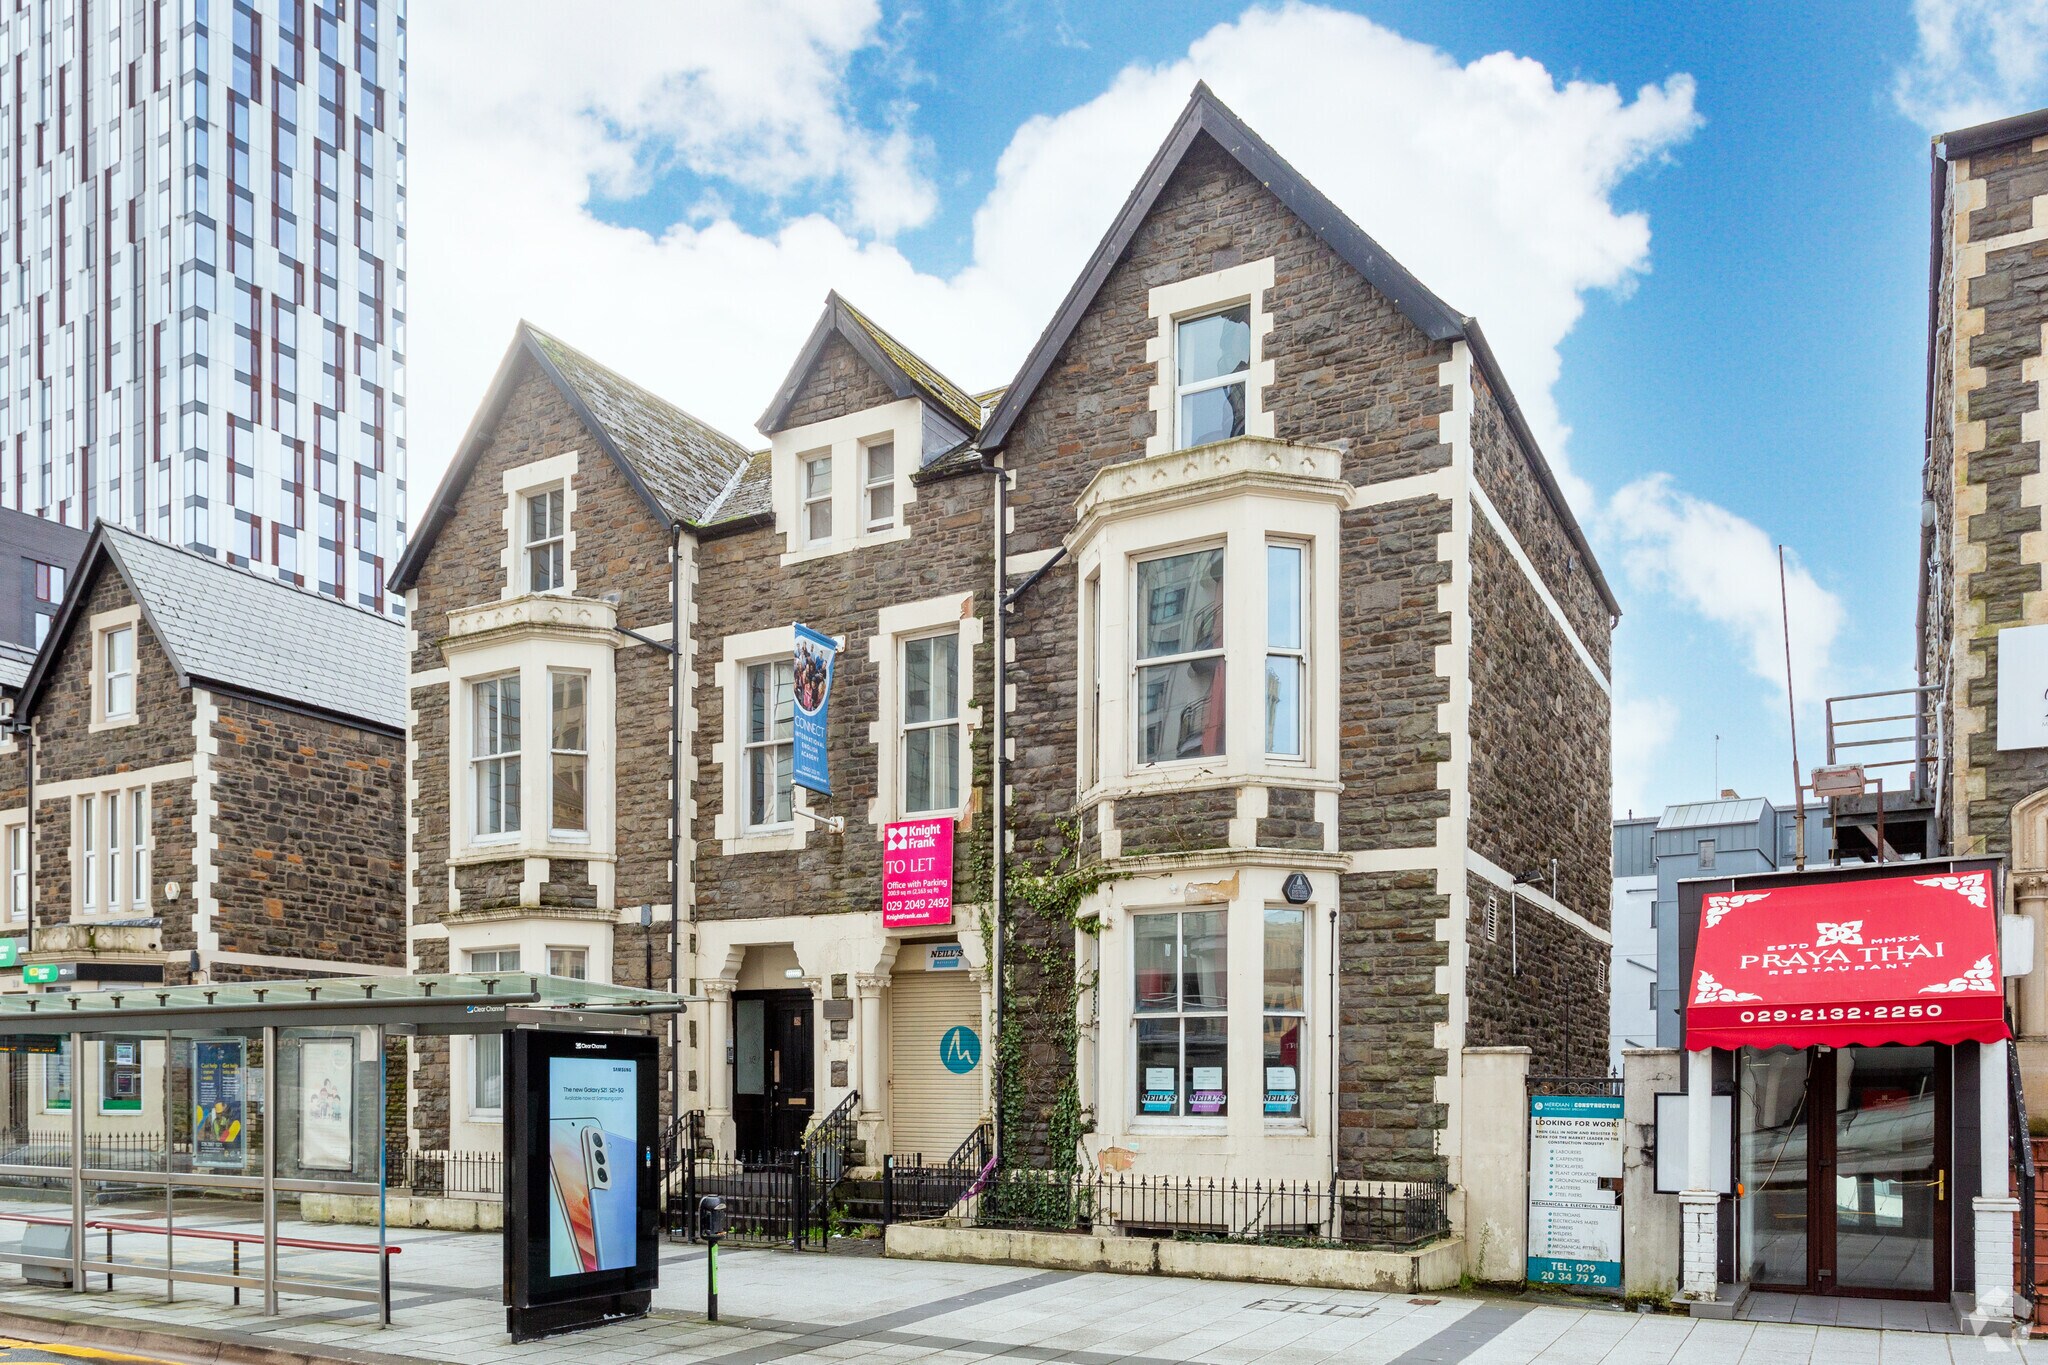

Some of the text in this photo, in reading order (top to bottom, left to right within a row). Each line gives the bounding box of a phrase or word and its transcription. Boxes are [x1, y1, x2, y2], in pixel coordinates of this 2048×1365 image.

[794, 716, 824, 738] CONNECT
[795, 731, 824, 748] INTERNATIONAL
[802, 742, 818, 753] ENGLISH
[801, 751, 819, 762] ACADEMY
[909, 824, 940, 837] Knight
[909, 837, 935, 849] Frank
[886, 857, 935, 874] TO LET
[907, 880, 921, 888] with
[923, 879, 947, 887] Parking
[886, 898, 949, 911] 029 2049 2492
[886, 912, 929, 921] KnightFrank.co.uk
[1871, 935, 1920, 944] MMXX
[1766, 943, 1809, 952] ESTD
[930, 950, 964, 958] NEILL'S
[1740, 942, 1945, 969] PRAYA THAI
[1768, 962, 1912, 975] RESTAURANT
[1551, 1262, 1596, 1273] TEL: 029
[1541, 1271, 1606, 1284] 20 34 79 20
